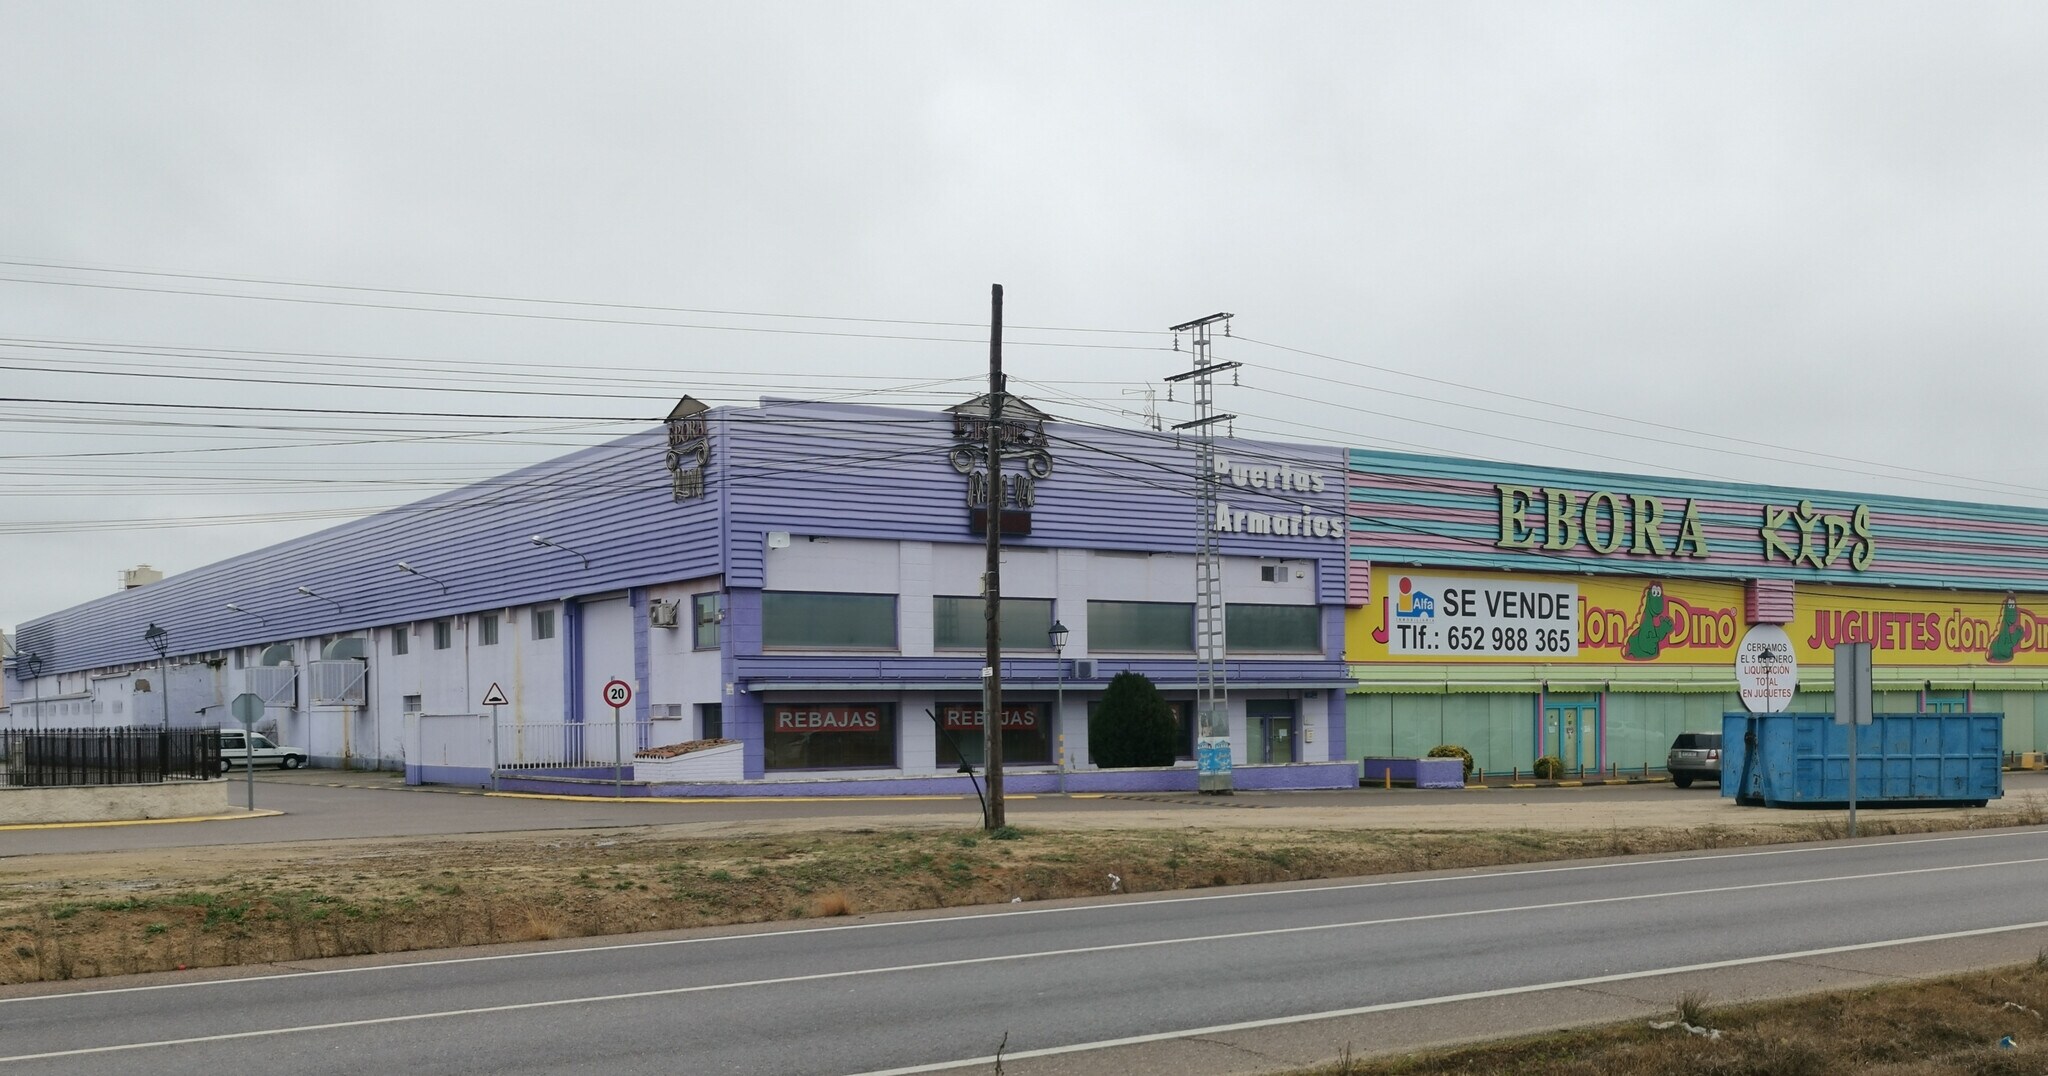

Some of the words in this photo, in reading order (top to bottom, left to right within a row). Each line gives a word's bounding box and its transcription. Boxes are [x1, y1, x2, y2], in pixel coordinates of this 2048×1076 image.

[1213, 454, 1325, 492] Puertas
[1213, 502, 1344, 538] Armarios
[1496, 484, 1711, 558] EBORA
[1413, 598, 1434, 610] Alfa
[1443, 588, 1477, 617] SE
[1484, 590, 1570, 620] VENDE
[1397, 624, 1439, 649] Tlf.:
[1447, 625, 1484, 650] 652
[1491, 626, 1528, 651] 988
[1535, 628, 1570, 652] 365
[1807, 609, 1941, 651] JUGUETES
[1946, 609, 1989, 651] don
[1746, 643, 1787, 652] CERRAMOS
[1740, 655, 1750, 664] EL
[1751, 655, 1756, 664] 5
[1756, 677, 1778, 686] TOTAL
[611, 688, 625, 700] 20
[1743, 689, 1753, 698] EN
[1754, 689, 1791, 698] JUGUETES
[779, 711, 878, 728] REBAJAS
[947, 710, 1035, 726] REBJAS
